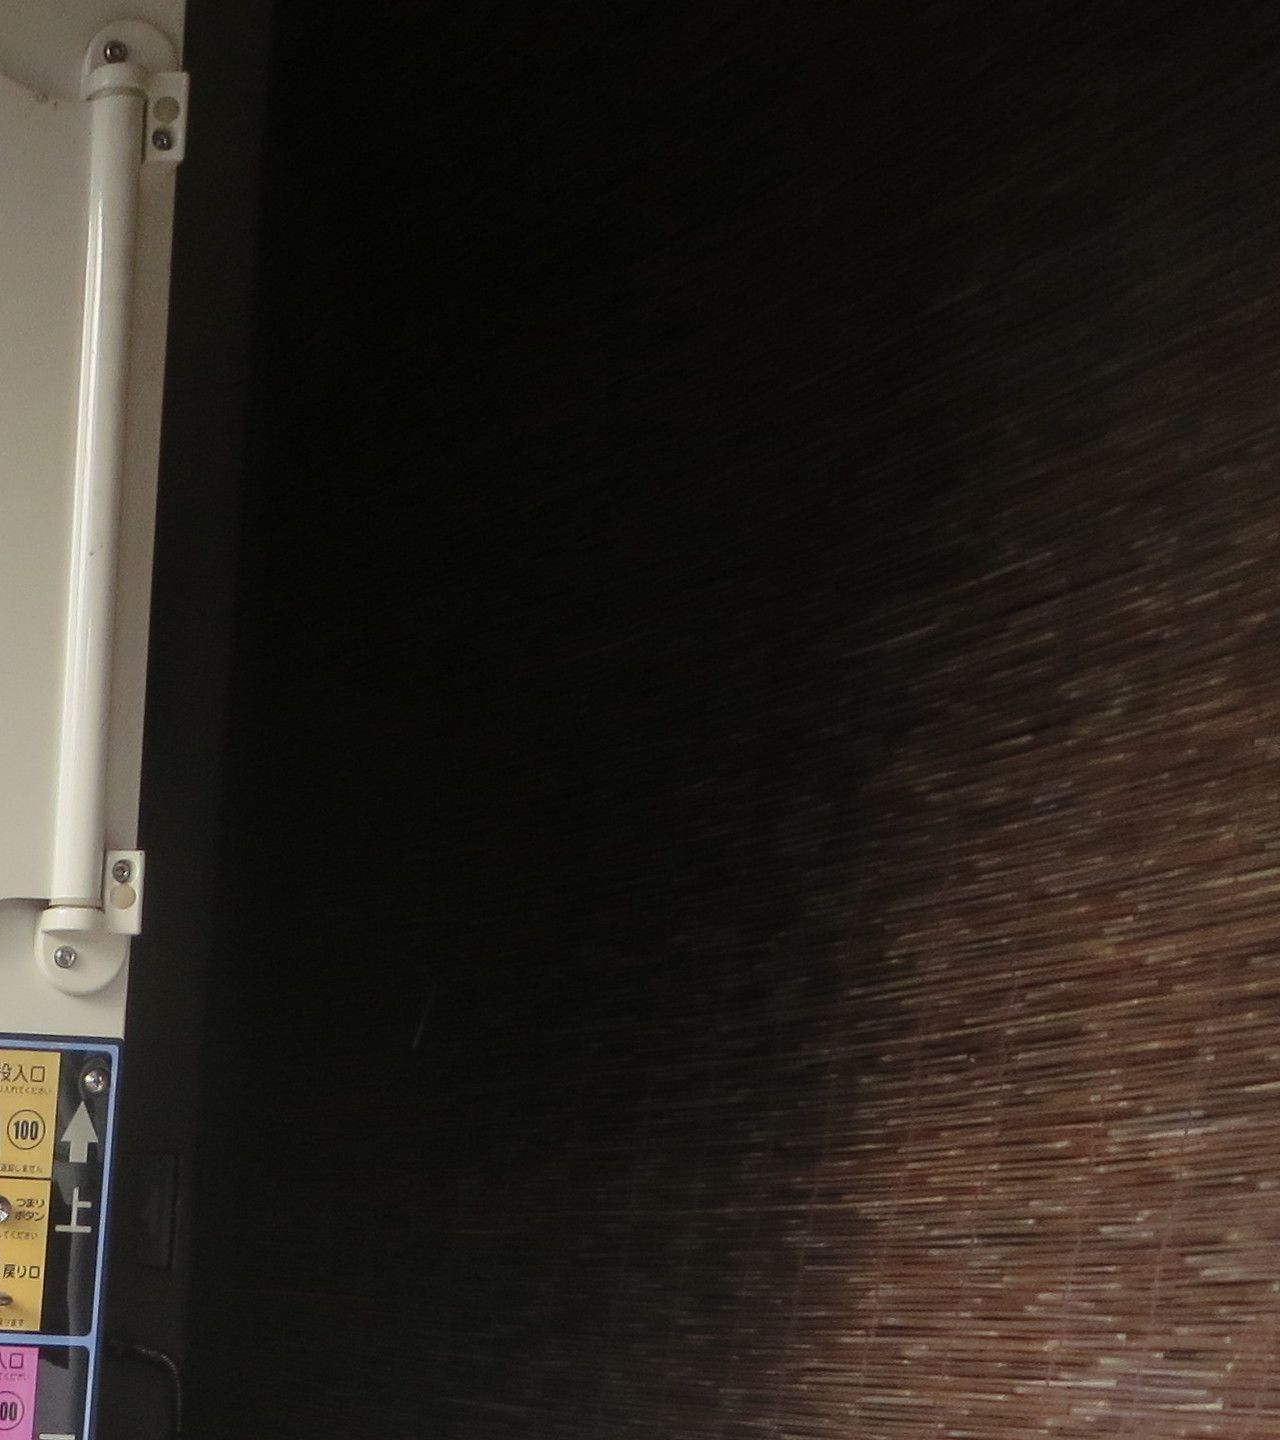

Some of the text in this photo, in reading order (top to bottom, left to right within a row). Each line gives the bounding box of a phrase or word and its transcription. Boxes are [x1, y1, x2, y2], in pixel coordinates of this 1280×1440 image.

[14, 1120, 38, 1140] 100
[16, 1198, 45, 1208] つまり
[55, 1187, 92, 1233] 上
[15, 1211, 45, 1222] ボタン
[3, 1264, 40, 1279] 戻り口
